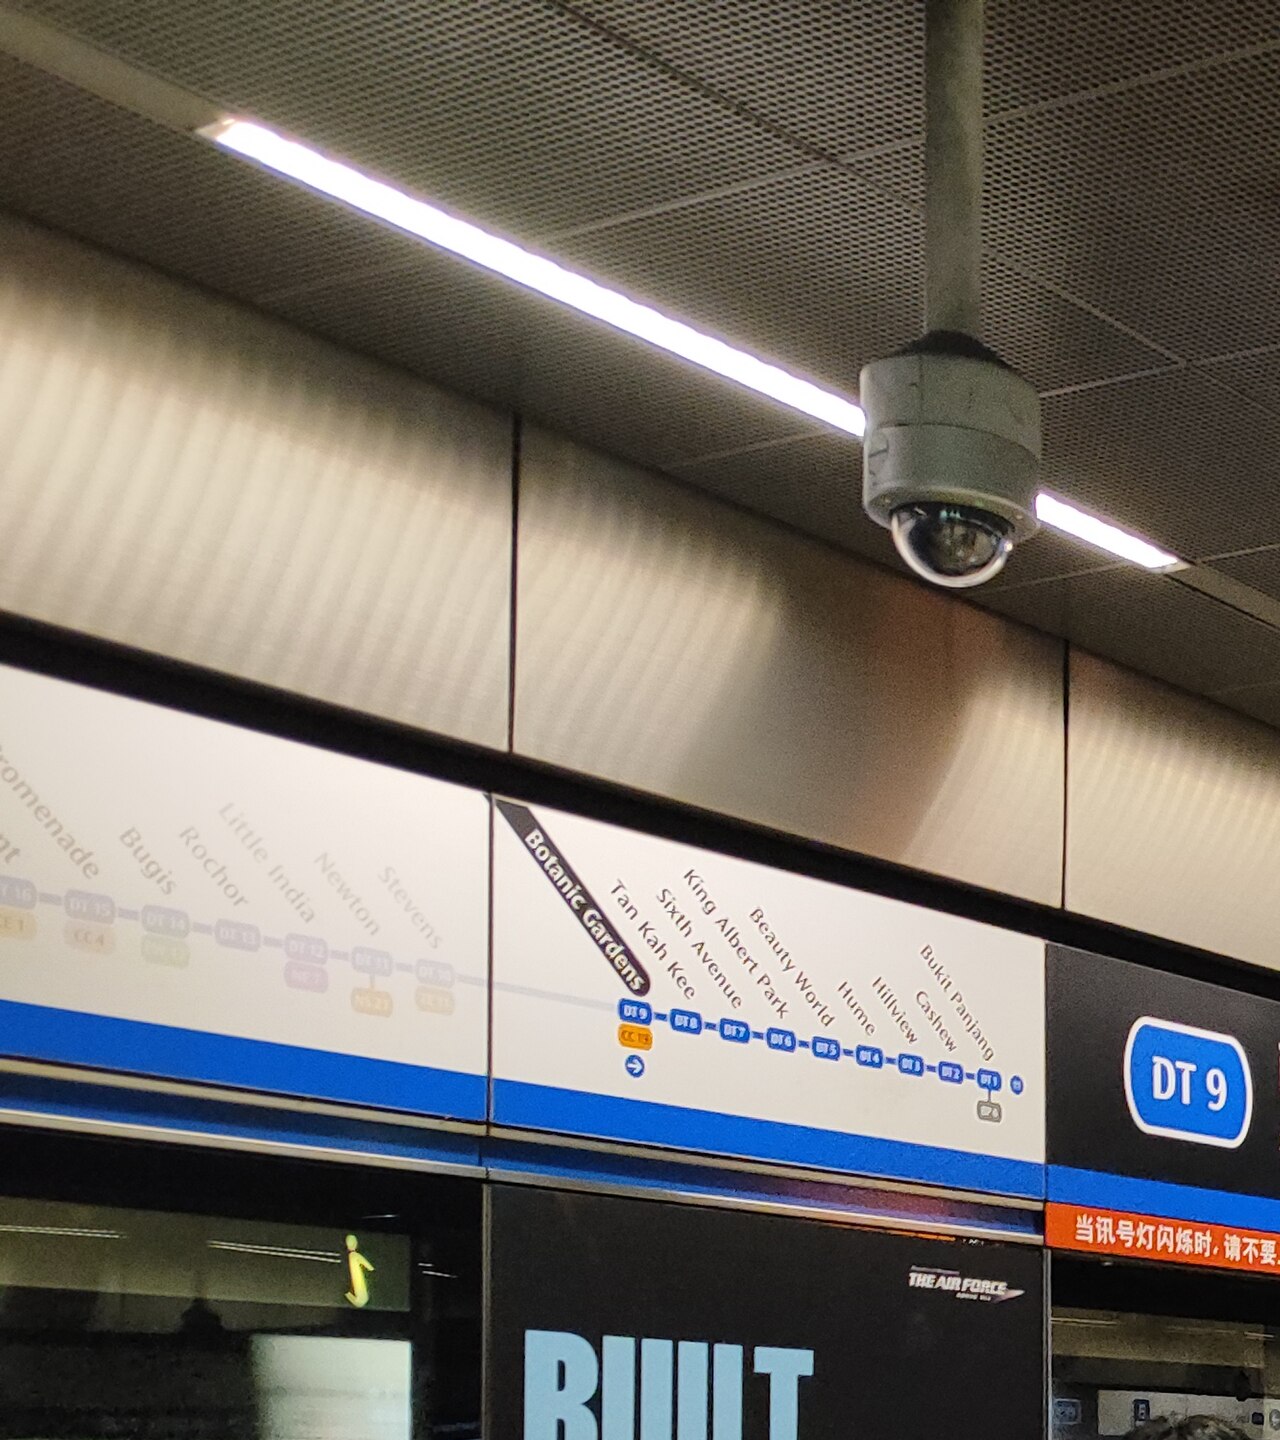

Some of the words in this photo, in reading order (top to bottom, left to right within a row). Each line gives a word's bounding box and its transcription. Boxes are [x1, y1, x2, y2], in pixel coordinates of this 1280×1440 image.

[0, 745, 100, 880] romenade
[119, 826, 178, 896] Bugis
[178, 825, 250, 907] Rochor
[218, 801, 269, 864] Little
[268, 855, 317, 924] India
[313, 851, 382, 937] Newton
[377, 866, 444, 950] Stevens
[524, 828, 588, 910] Botanic
[580, 906, 647, 993] Gardens
[609, 878, 639, 921] Tan
[637, 920, 668, 962] Kah
[667, 961, 698, 1001] Kee
[655, 887, 694, 939] Sixth
[691, 940, 744, 1010] Avenue
[682, 867, 718, 917] King
[714, 917, 760, 975] Albert
[756, 972, 792, 1021] Park
[748, 905, 797, 973] Beauty
[793, 970, 837, 1029] World
[836, 980, 877, 1037] Hume
[871, 975, 919, 1045] Hillview
[919, 943, 957, 995] Bukit
[949, 990, 995, 1063] Panjang
[914, 989, 957, 1053] Cashew
[1151, 1055, 1197, 1107] DT
[1206, 1066, 1228, 1113] 9
[908, 1272, 936, 1289] THE
[935, 1275, 962, 1292] AIR
[961, 1277, 1008, 1295] FORCE
